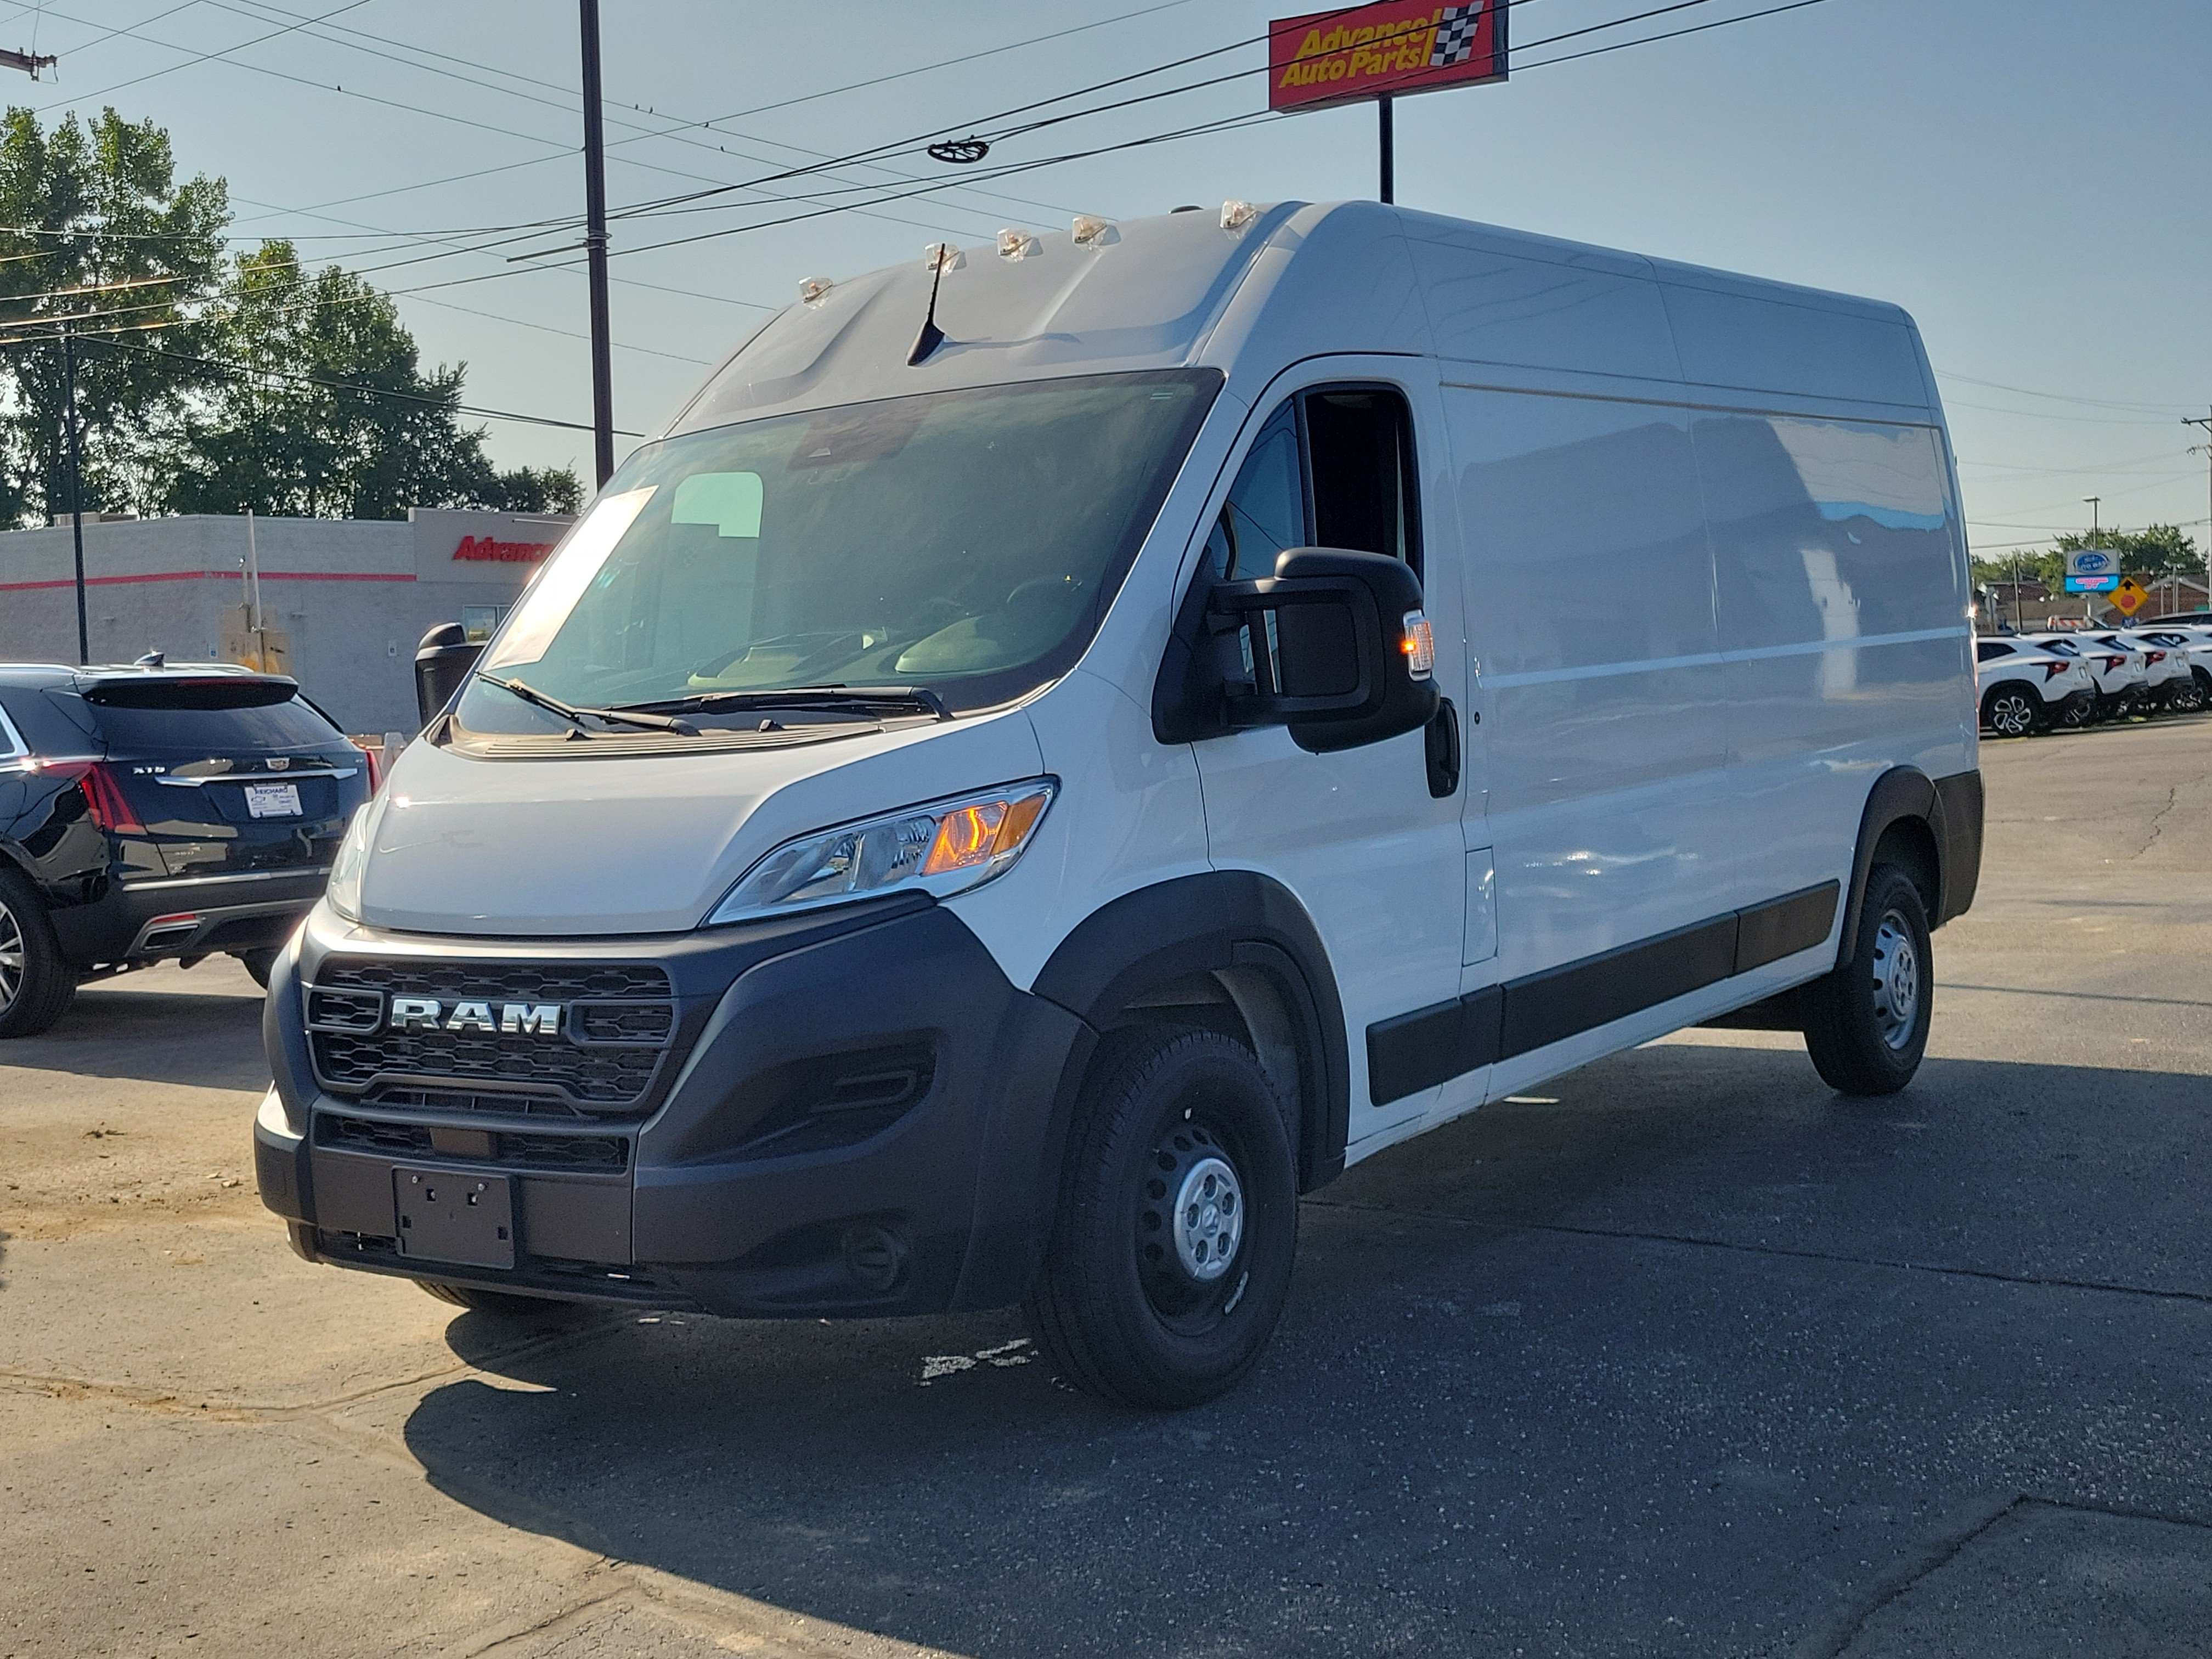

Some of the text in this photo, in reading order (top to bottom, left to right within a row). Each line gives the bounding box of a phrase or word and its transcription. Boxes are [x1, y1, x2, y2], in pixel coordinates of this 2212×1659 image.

[1295, 17, 1429, 59] Advance
[1278, 45, 1421, 89] Auto Parts
[391, 998, 562, 1035] RAM
